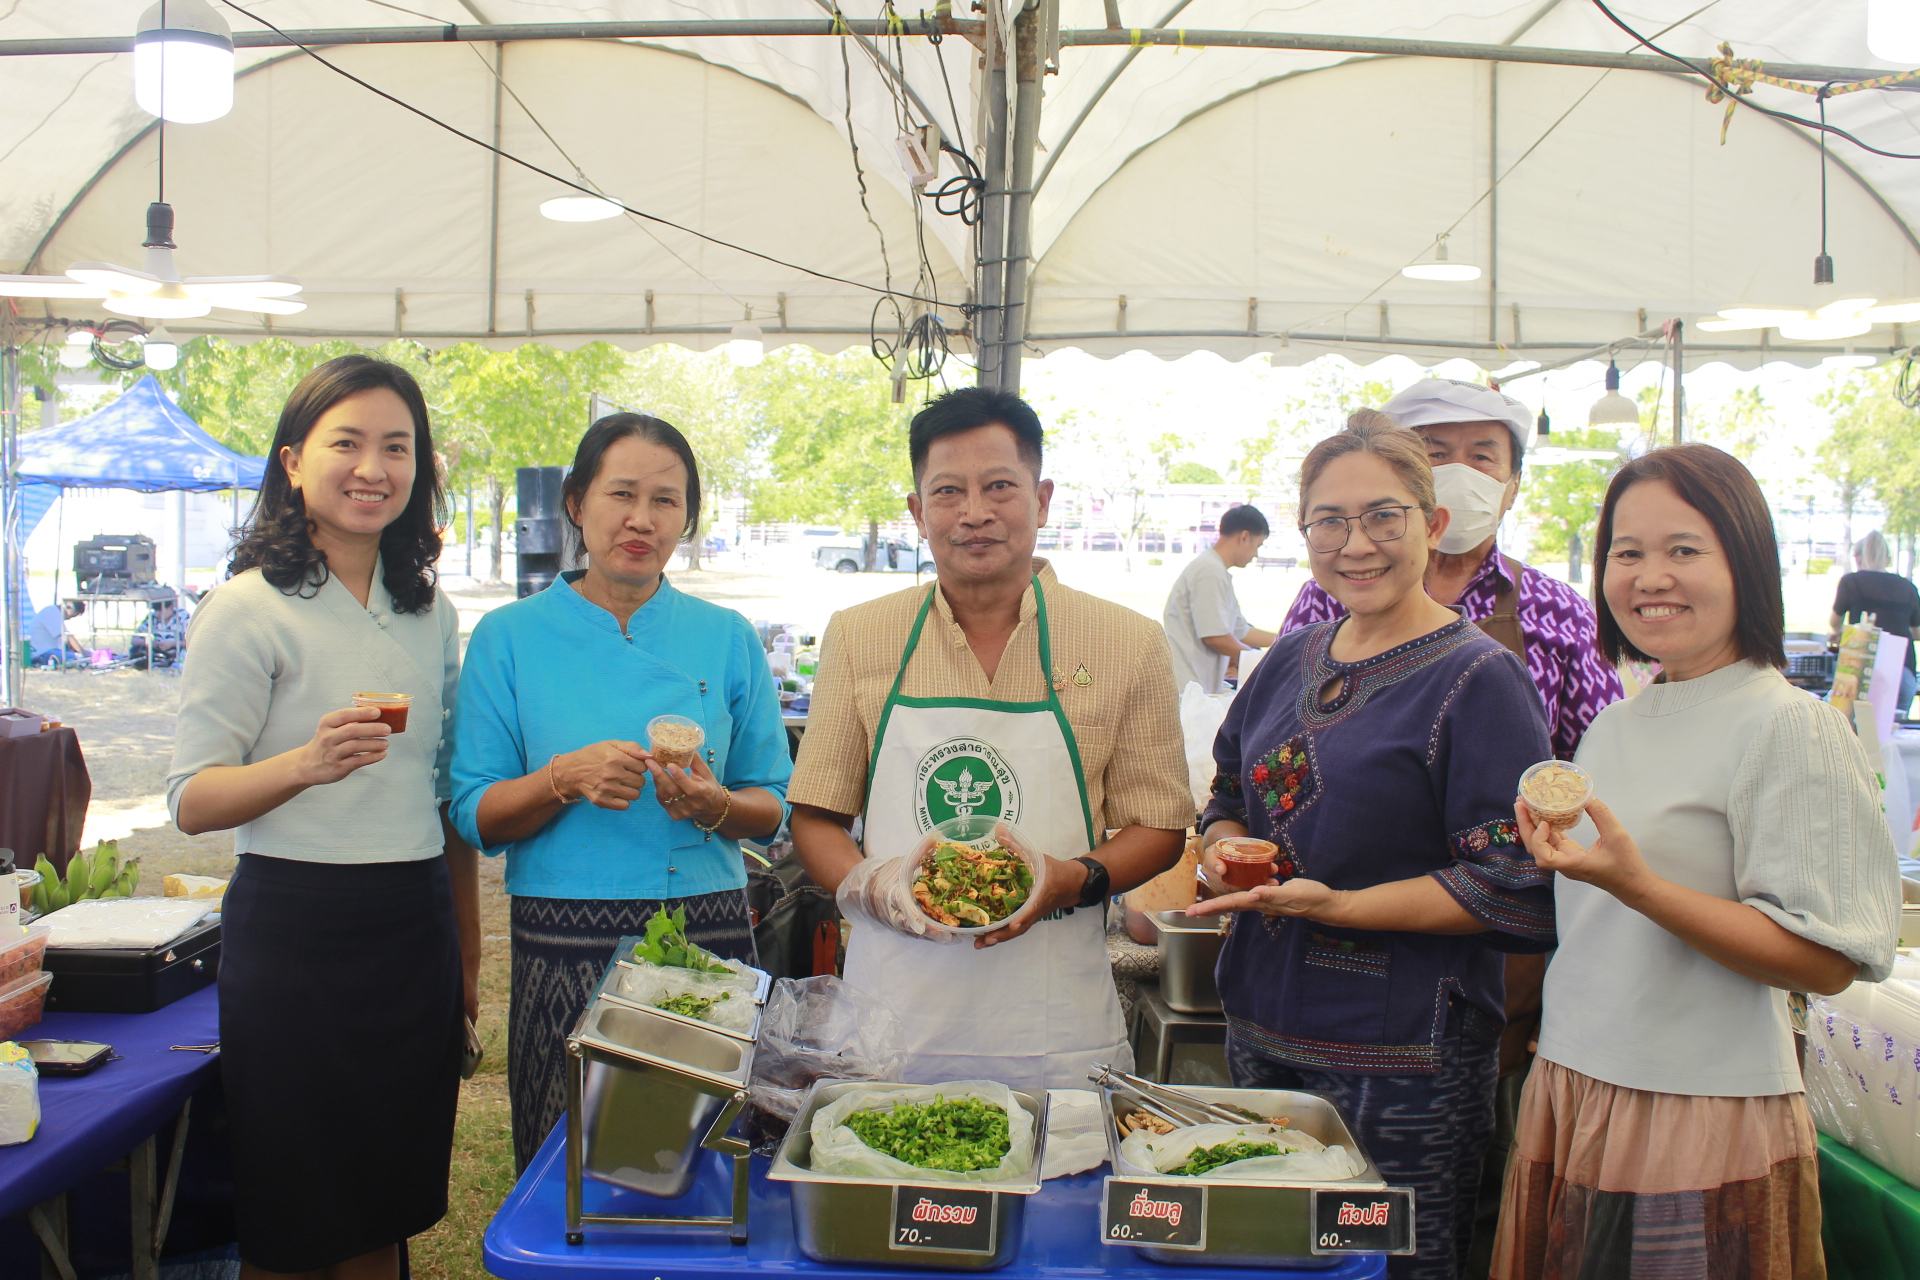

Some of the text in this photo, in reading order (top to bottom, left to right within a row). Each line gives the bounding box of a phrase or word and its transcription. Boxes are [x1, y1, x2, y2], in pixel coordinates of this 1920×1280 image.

[919, 743, 1011, 785] กระทรวงสาธารณสุข
[919, 806, 932, 832] MINIS
[912, 1197, 978, 1225] ผักรวม
[1129, 1188, 1183, 1226] ถั่วพลู
[1337, 1201, 1389, 1225] หัวปลี
[898, 1227, 932, 1243] 70.-
[1110, 1223, 1143, 1239] 60.-
[1319, 1232, 1351, 1247] 60.-
